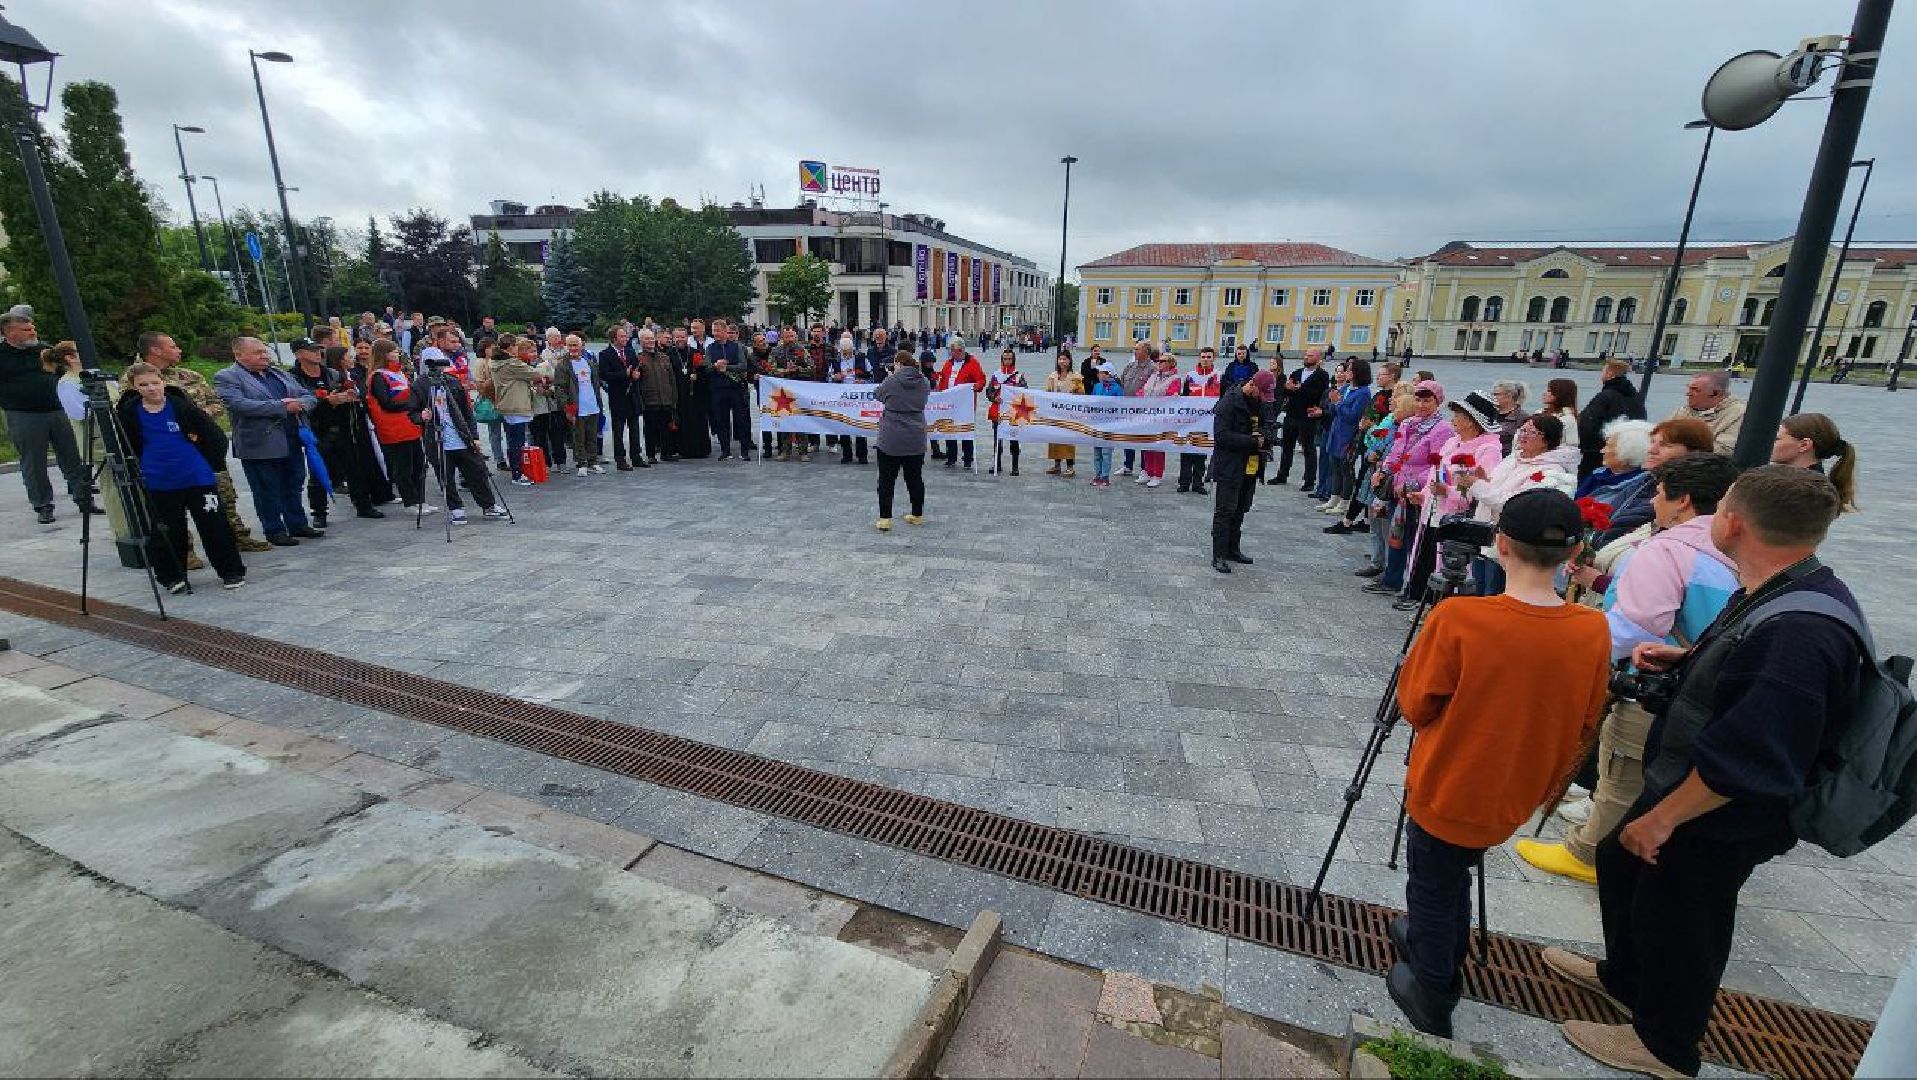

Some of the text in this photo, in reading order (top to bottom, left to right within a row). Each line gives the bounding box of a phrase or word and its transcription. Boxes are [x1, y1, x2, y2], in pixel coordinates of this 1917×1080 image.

[1051, 401, 1119, 414] НАСЛЕДНИКИ
[1120, 407, 1166, 416] ПОБЕДЫ
[1168, 407, 1176, 415] В
